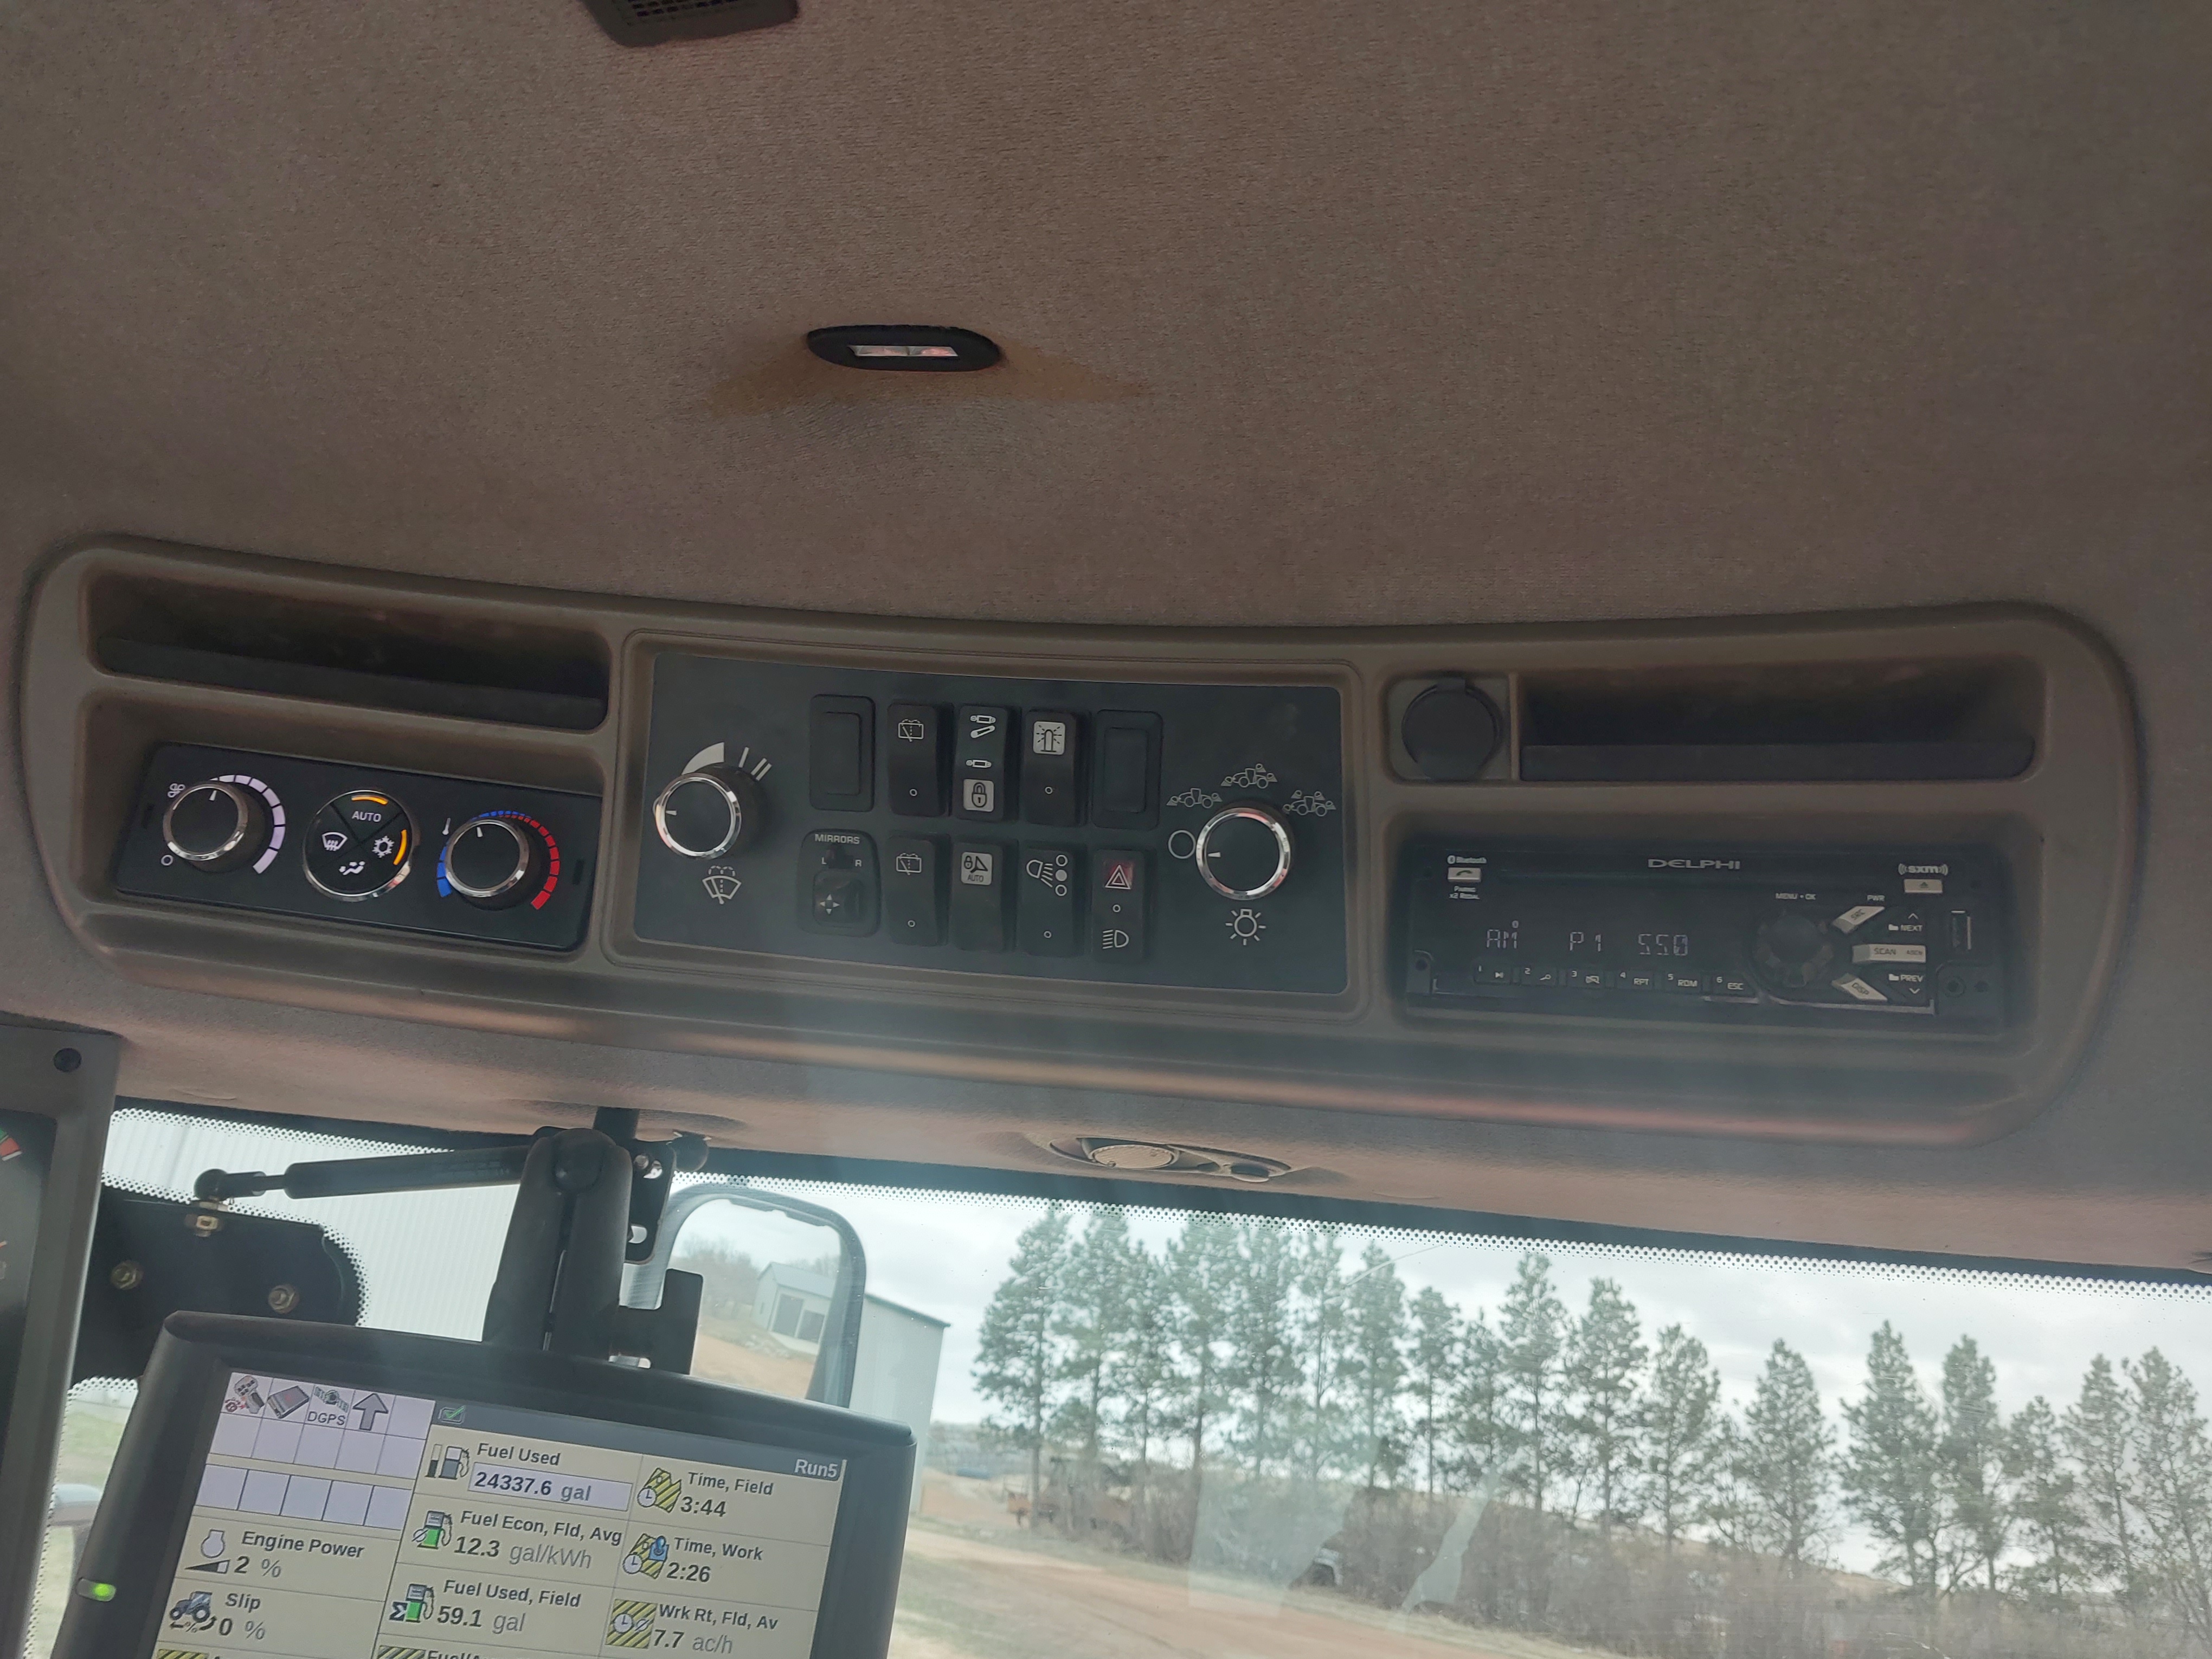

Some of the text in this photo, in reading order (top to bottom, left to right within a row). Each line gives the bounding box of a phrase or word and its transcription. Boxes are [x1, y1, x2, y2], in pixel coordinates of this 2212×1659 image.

[352, 810, 382, 822] AUTO
[815, 833, 860, 845] MIRRORS
[821, 857, 827, 865] L
[855, 859, 862, 867] R
[1648, 858, 1740, 869] DELPHI
[1908, 865, 1939, 873] sxm
[967, 874, 984, 883] AUTO
[1900, 924, 1923, 933] NEXT
[1873, 947, 1896, 956] SCAN
[1678, 979, 1698, 987] RDM
[306, 1411, 345, 1426] DGPS
[477, 1443, 561, 1466] Fuel Used
[794, 1458, 838, 1478] Run5
[475, 1471, 591, 1502] 24337.6 gal
[687, 1471, 774, 1496] Time, Field
[680, 1496, 727, 1517] 3:44
[460, 1510, 622, 1546] Fuel Econ, Fld, Avg
[241, 1531, 365, 1559] Engine Power
[454, 1536, 592, 1569] 12.3 gal/kWh
[673, 1537, 763, 1561] Time, Work
[234, 1557, 281, 1578] 2 %
[666, 1562, 711, 1583] 2:26
[225, 1593, 261, 1614] Slip
[443, 1580, 581, 1608] Fuel Used, Field
[436, 1605, 526, 1635] 59.1 gal
[658, 1603, 779, 1630] Wrk Rt, Fld, Av
[218, 1618, 266, 1641] 0 %
[653, 1629, 734, 1654] 7.7 ac/h
